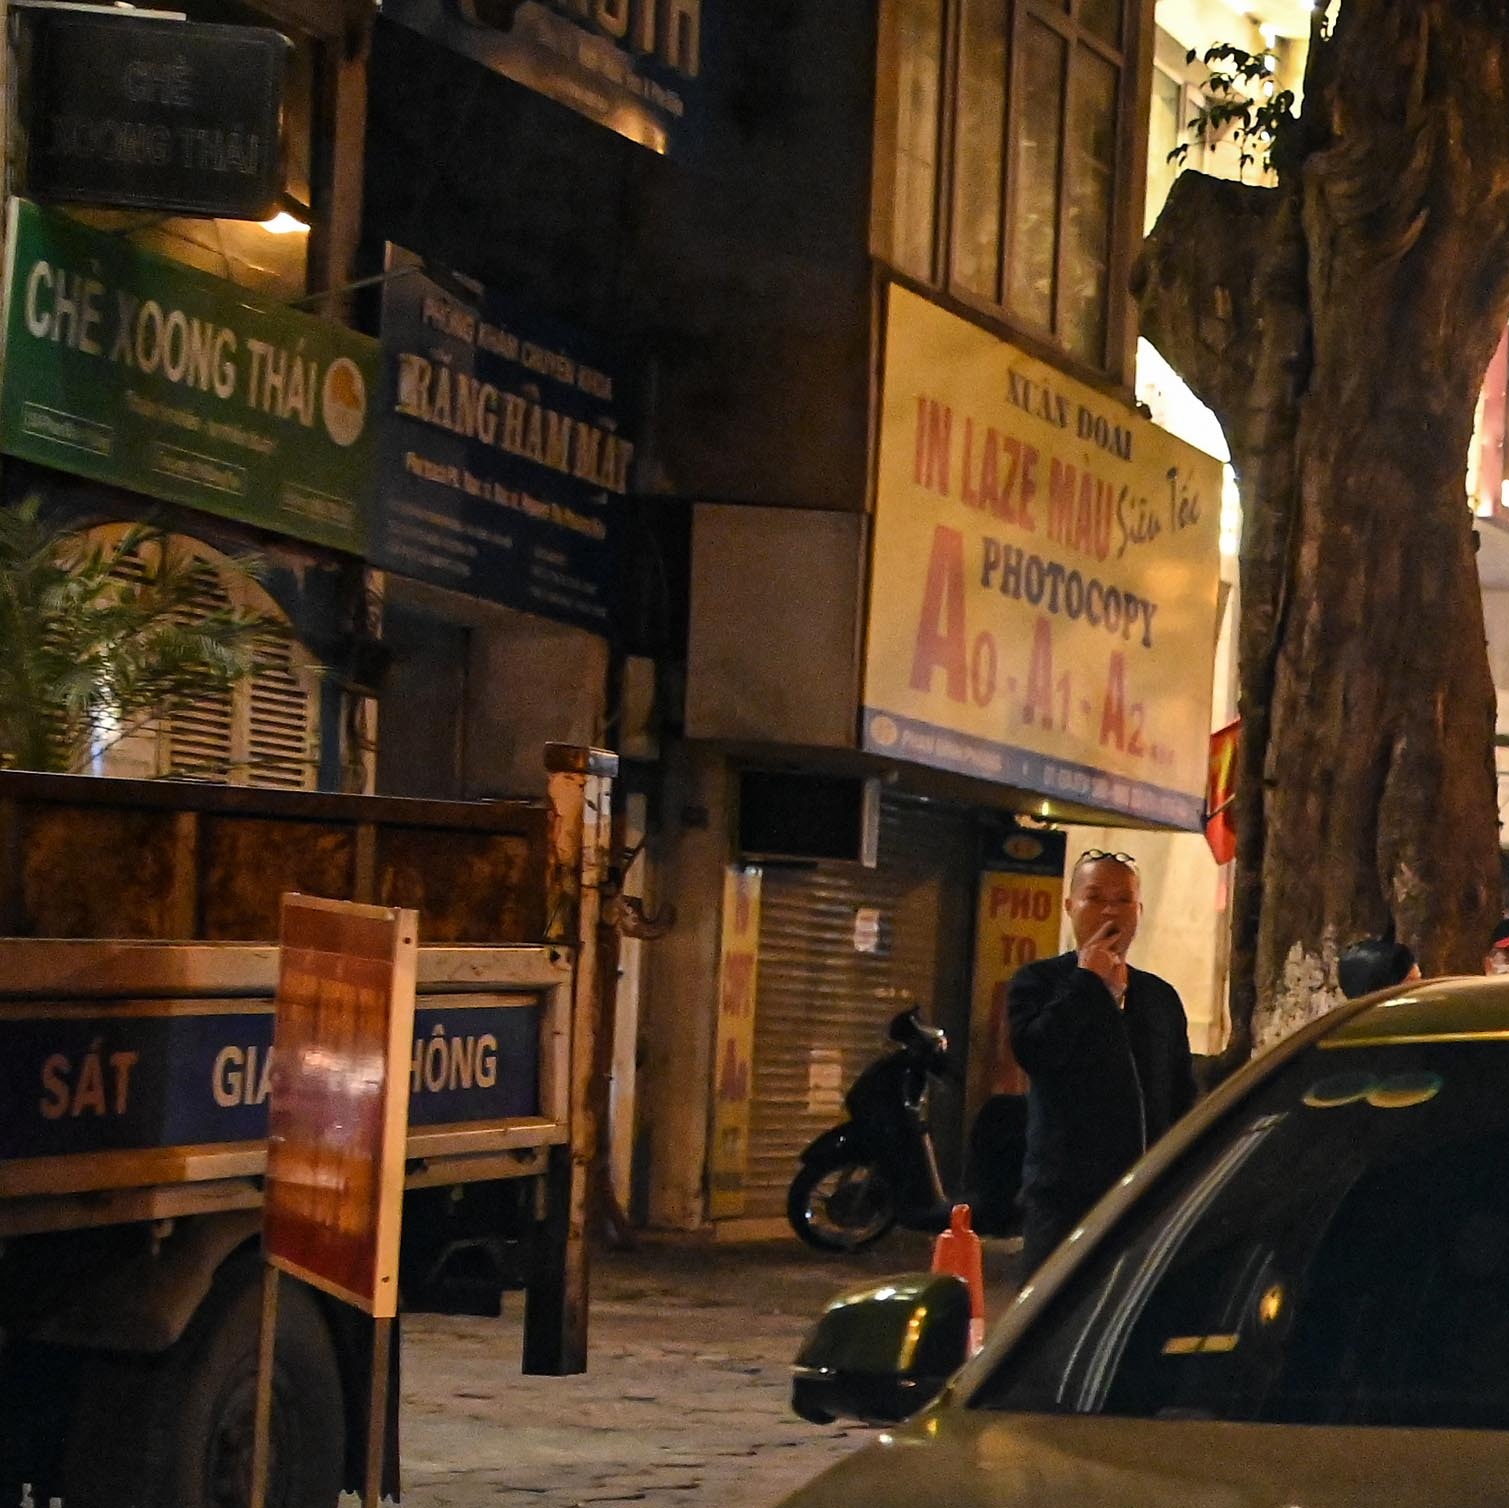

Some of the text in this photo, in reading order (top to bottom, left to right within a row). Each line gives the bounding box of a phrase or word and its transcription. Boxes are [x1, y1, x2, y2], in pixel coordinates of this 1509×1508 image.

[111, 288, 237, 399] XOONG
[245, 336, 319, 430] THÁI
[914, 395, 953, 497] IN
[960, 415, 1040, 534] LAZE
[979, 535, 1158, 649] PHOTOCOPY
[40, 1036, 139, 1120] SÁT
[212, 1045, 273, 1107] GIA
